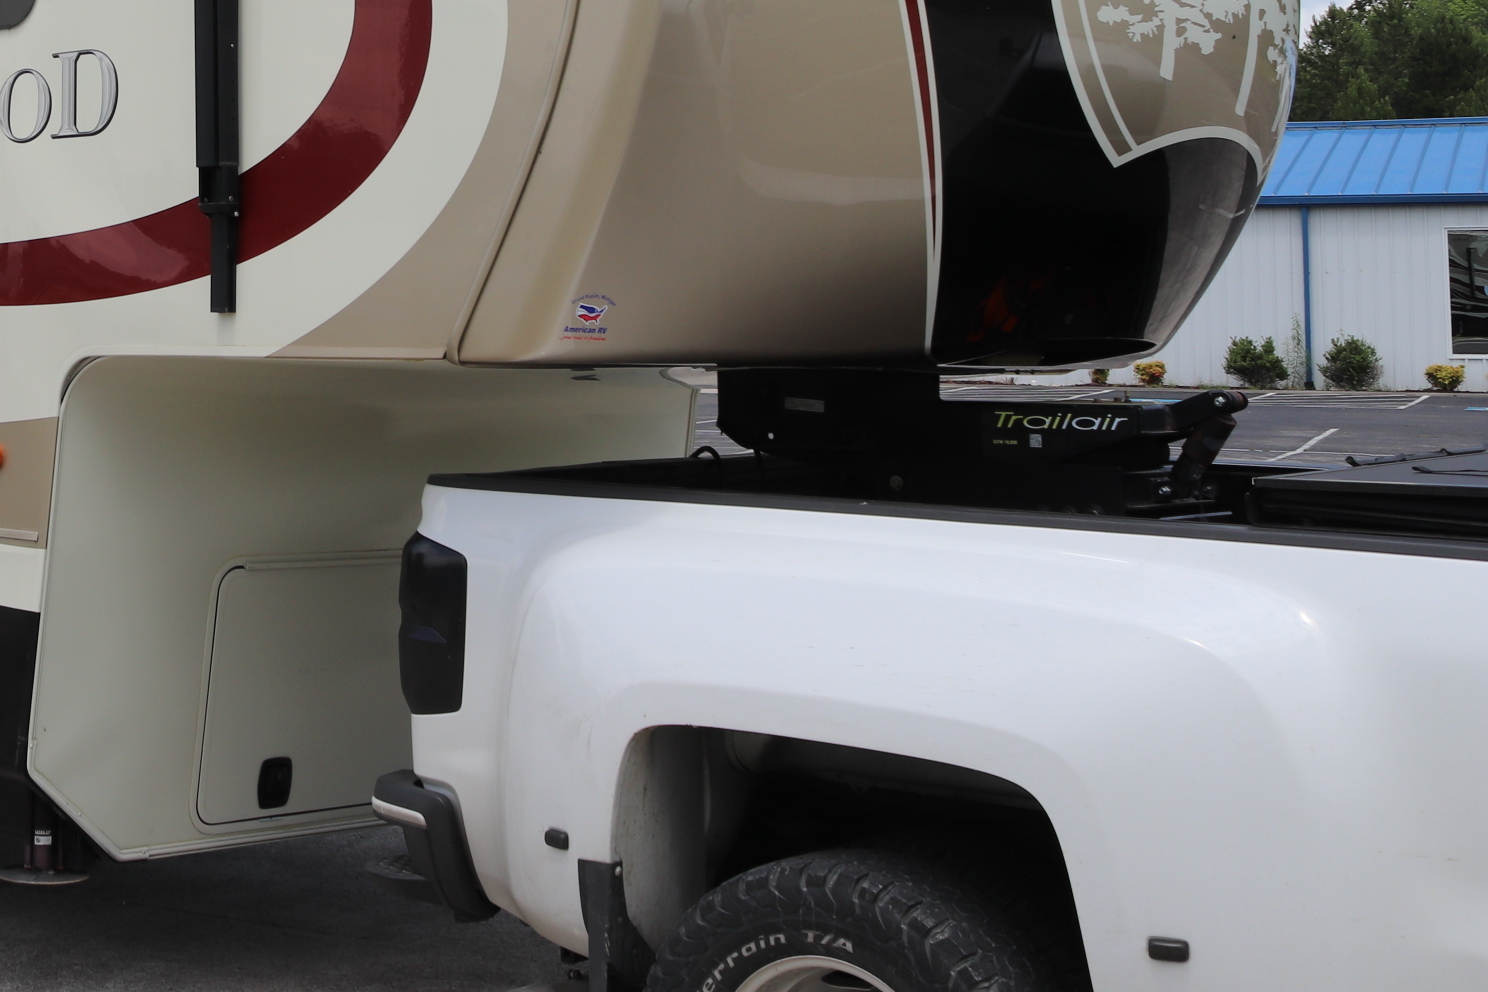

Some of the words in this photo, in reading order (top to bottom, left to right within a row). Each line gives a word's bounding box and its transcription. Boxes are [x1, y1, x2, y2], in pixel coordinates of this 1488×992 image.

[563, 325, 597, 334] American
[994, 411, 1129, 431] Trailair
[696, 933, 788, 992] errain
[801, 929, 855, 954] T/A
